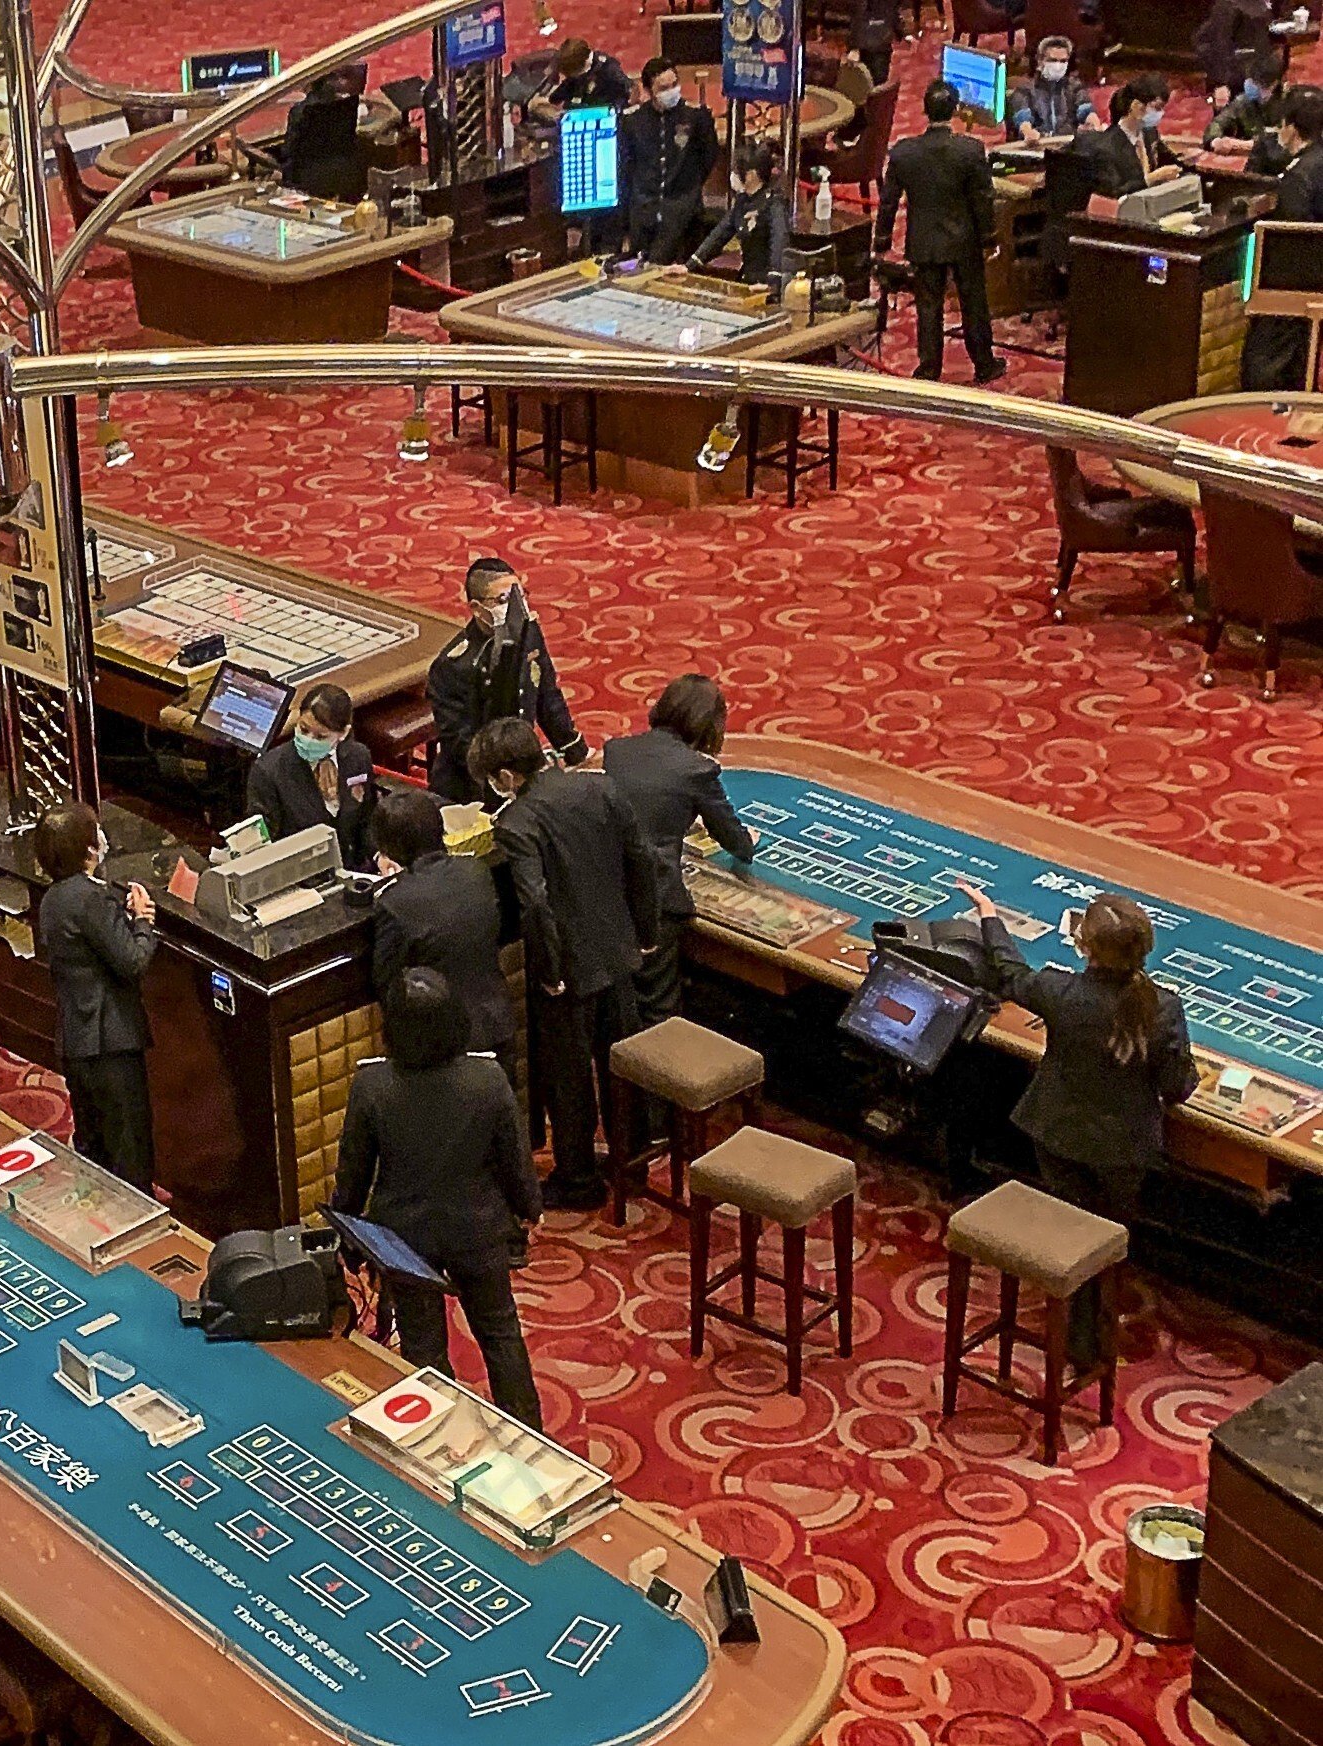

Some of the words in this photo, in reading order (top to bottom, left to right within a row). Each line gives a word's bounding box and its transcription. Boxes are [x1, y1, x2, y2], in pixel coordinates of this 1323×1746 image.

[12, 1271, 32, 1282] 7
[31, 1285, 50, 1297] 8
[50, 1298, 69, 1309] 9
[251, 1435, 272, 1448] 0
[274, 1453, 295, 1466] 1
[298, 1469, 321, 1483] 2
[324, 1487, 347, 1500] 3
[352, 1505, 373, 1518] 4
[377, 1523, 401, 1536] 5
[405, 1542, 426, 1555] 6
[432, 1558, 455, 1572] 7
[460, 1578, 482, 1593] 8
[486, 1597, 509, 1610] 9
[233, 1603, 266, 1634] Three
[264, 1629, 297, 1658] Cards
[294, 1652, 345, 1694] Baccarat
